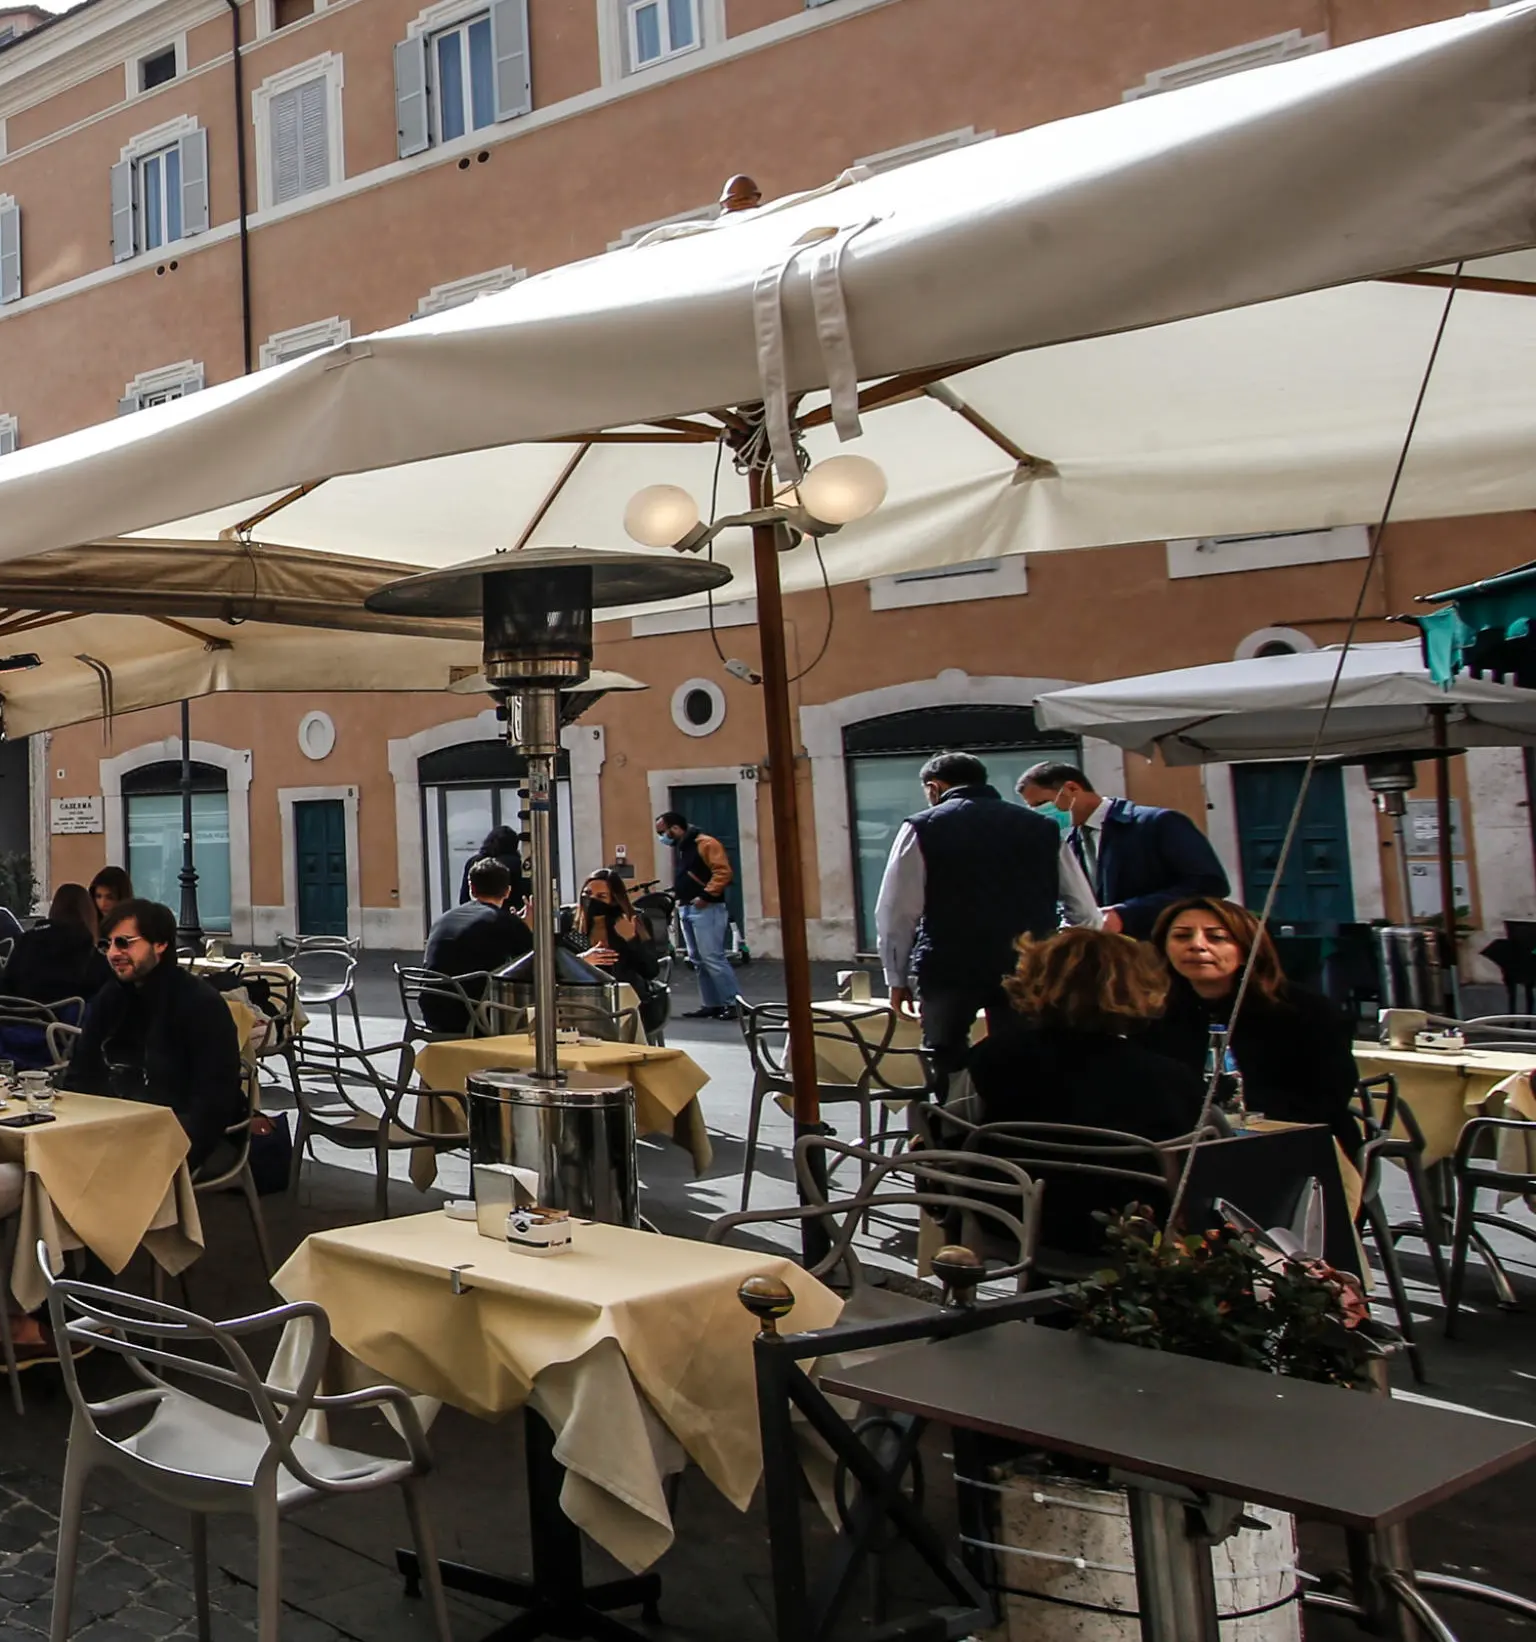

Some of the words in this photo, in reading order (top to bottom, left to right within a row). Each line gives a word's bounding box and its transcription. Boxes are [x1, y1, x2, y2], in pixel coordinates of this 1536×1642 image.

[593, 730, 600, 740] 9
[244, 754, 250, 763] 7
[740, 769, 756, 780] 10
